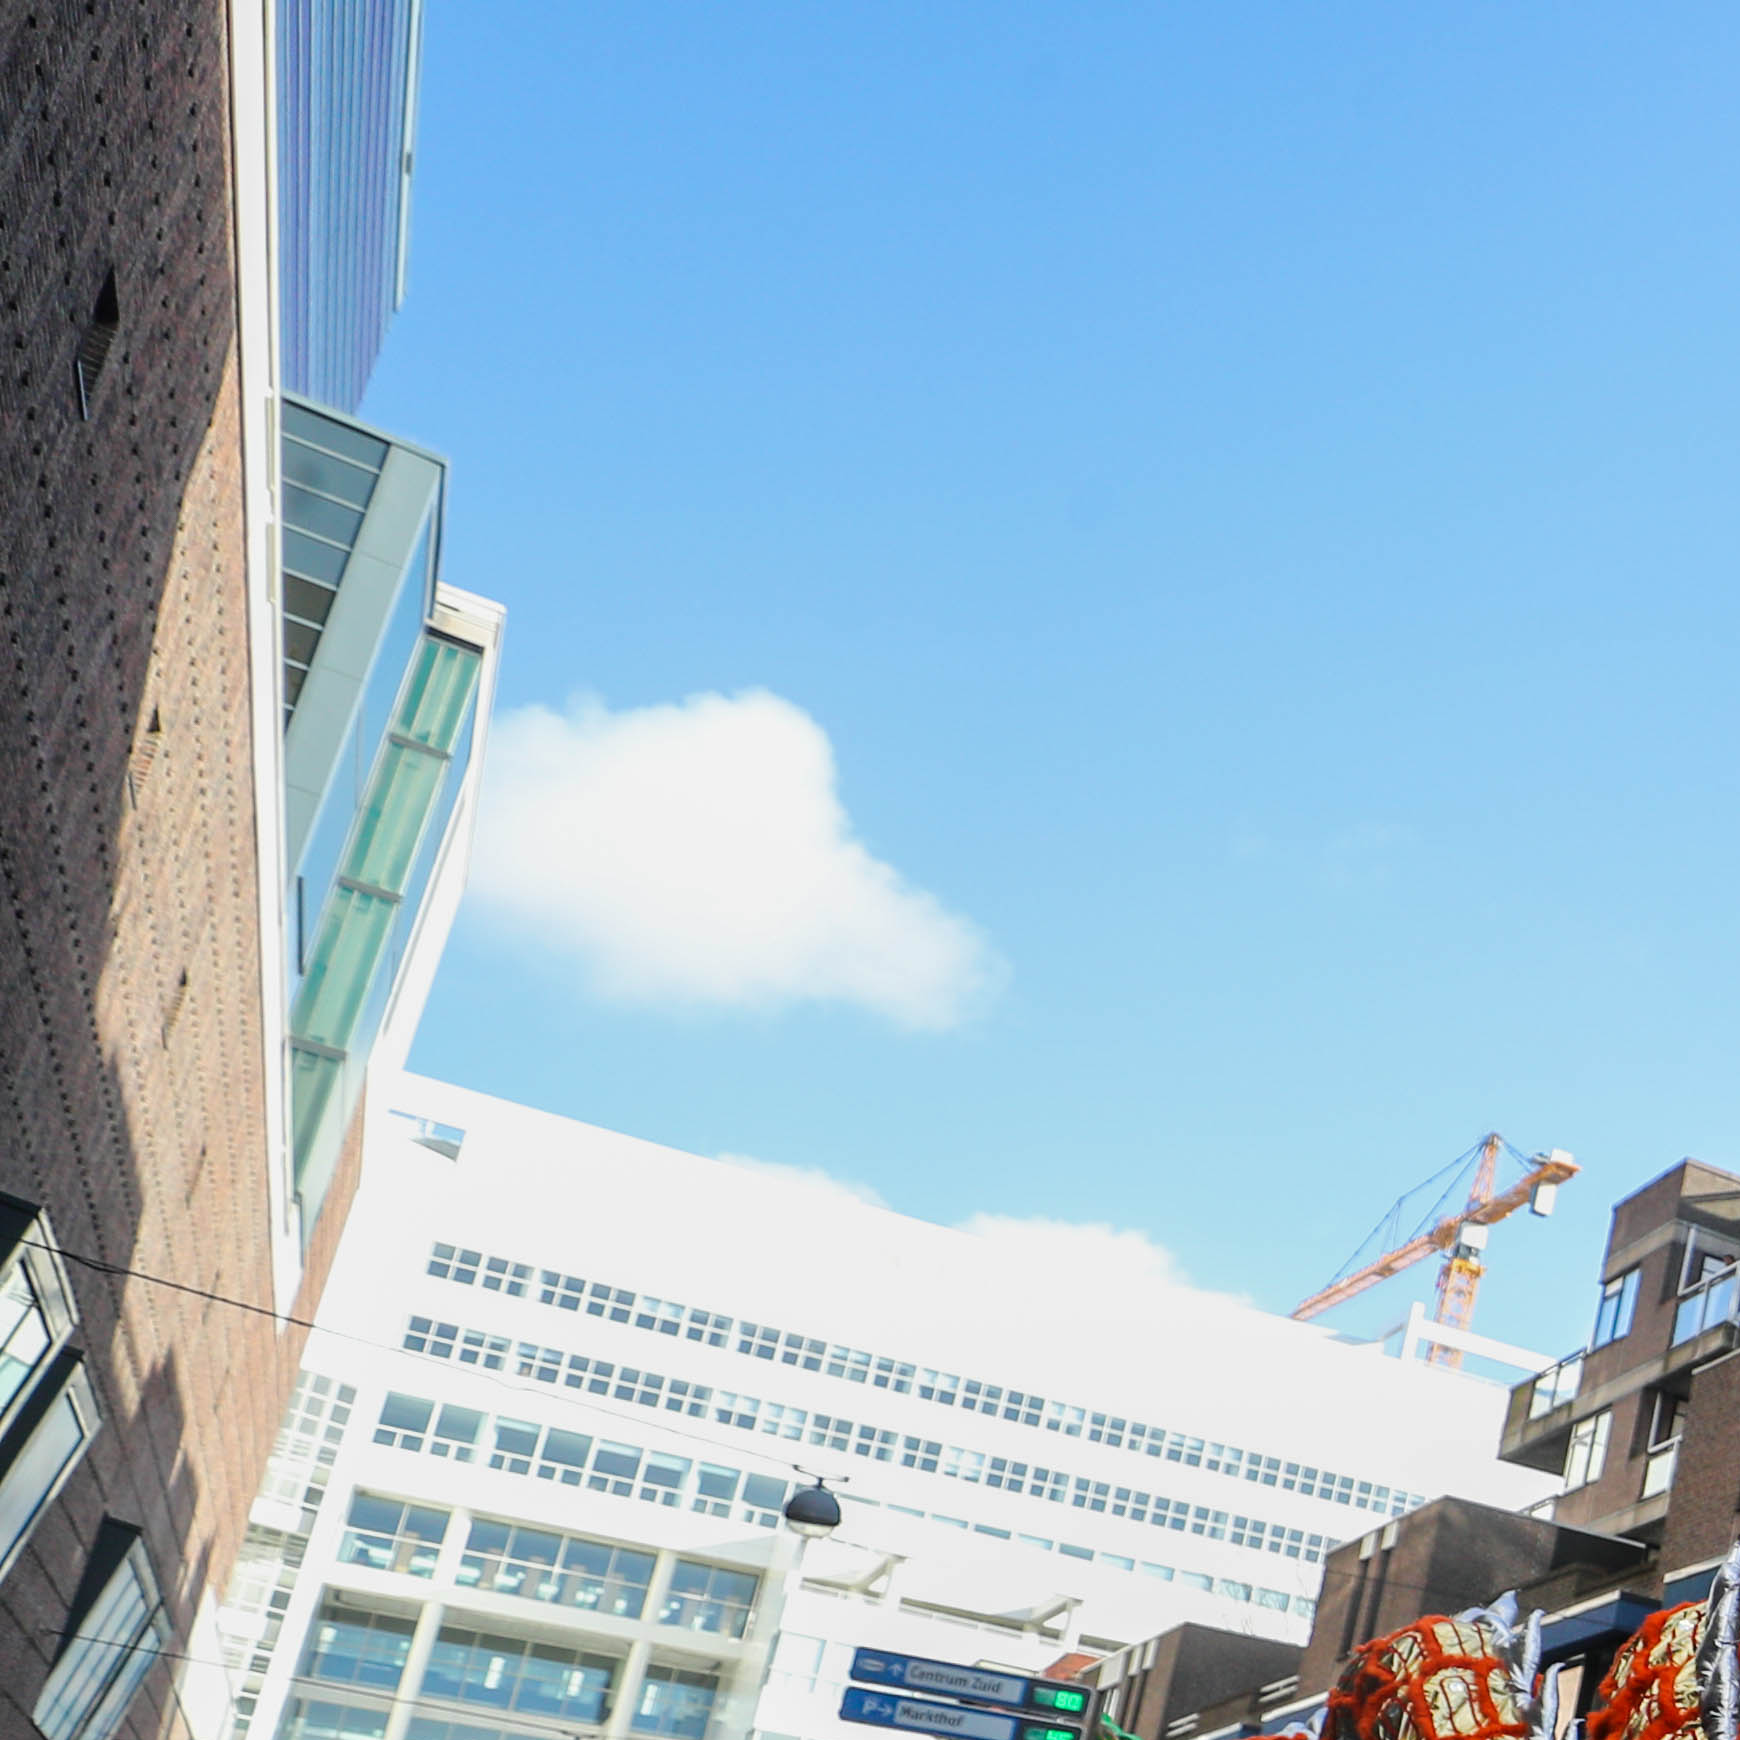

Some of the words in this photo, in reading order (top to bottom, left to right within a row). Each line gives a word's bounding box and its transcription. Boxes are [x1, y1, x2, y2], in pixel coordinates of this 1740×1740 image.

[909, 1666, 969, 1691] Centrum
[970, 1677, 1003, 1695] Zuid
[899, 1702, 965, 1728] Markthof
